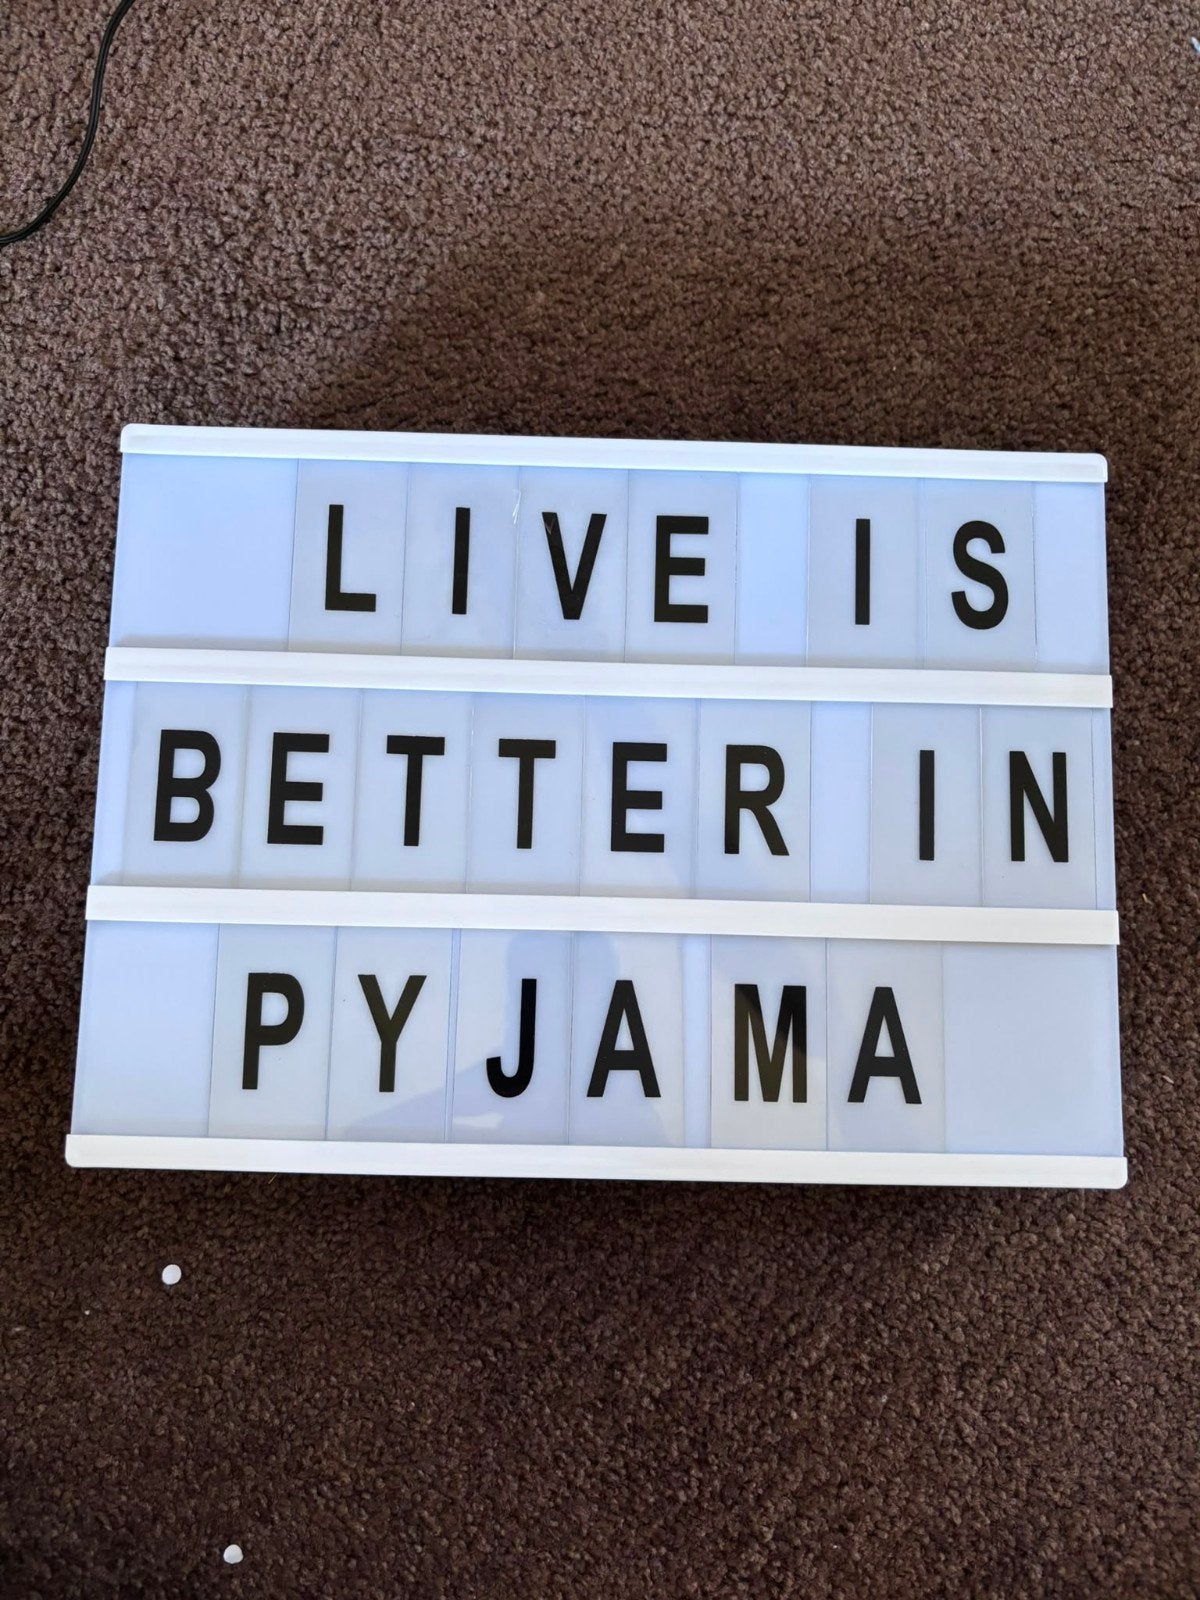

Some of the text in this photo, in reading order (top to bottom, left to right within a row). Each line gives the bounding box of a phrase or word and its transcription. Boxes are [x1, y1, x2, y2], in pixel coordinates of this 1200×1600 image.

[324, 504, 1009, 631] LIVE IS
[153, 729, 1069, 863] BETTER IN
[241, 972, 923, 1105] PYJAMA
